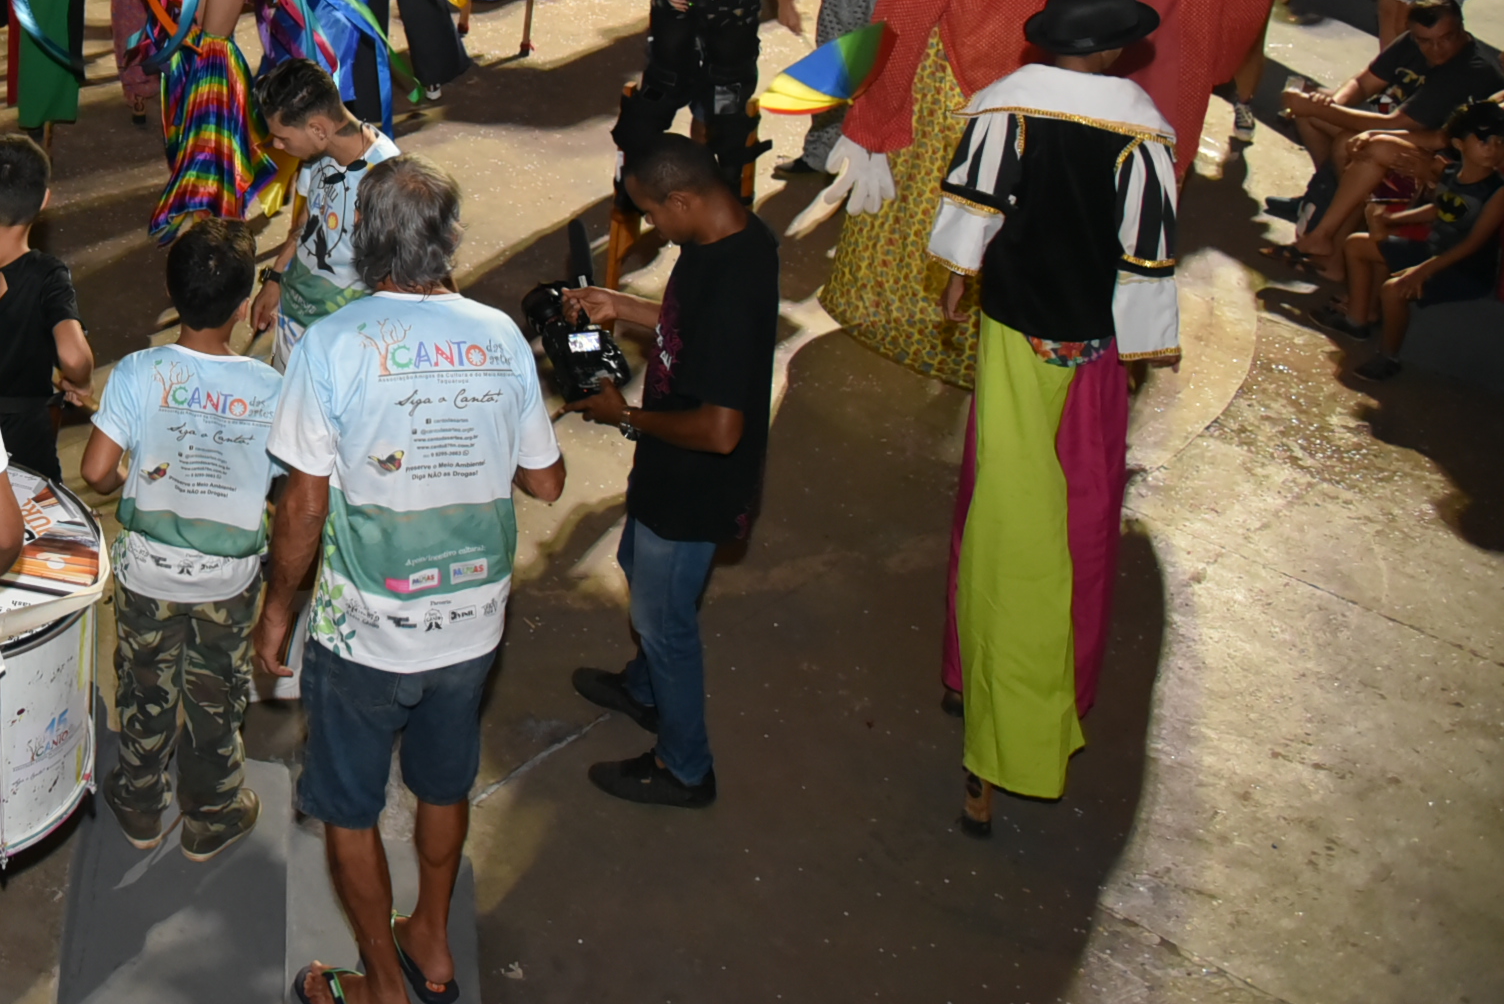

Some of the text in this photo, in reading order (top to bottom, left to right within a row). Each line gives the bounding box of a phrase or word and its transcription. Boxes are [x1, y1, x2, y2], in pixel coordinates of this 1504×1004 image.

[390, 340, 487, 369] CANTO
[171, 387, 265, 416] CANTO das
[394, 390, 432, 416] Siga
[454, 388, 503, 409] Canto!
[453, 564, 484, 576] PALMAS
